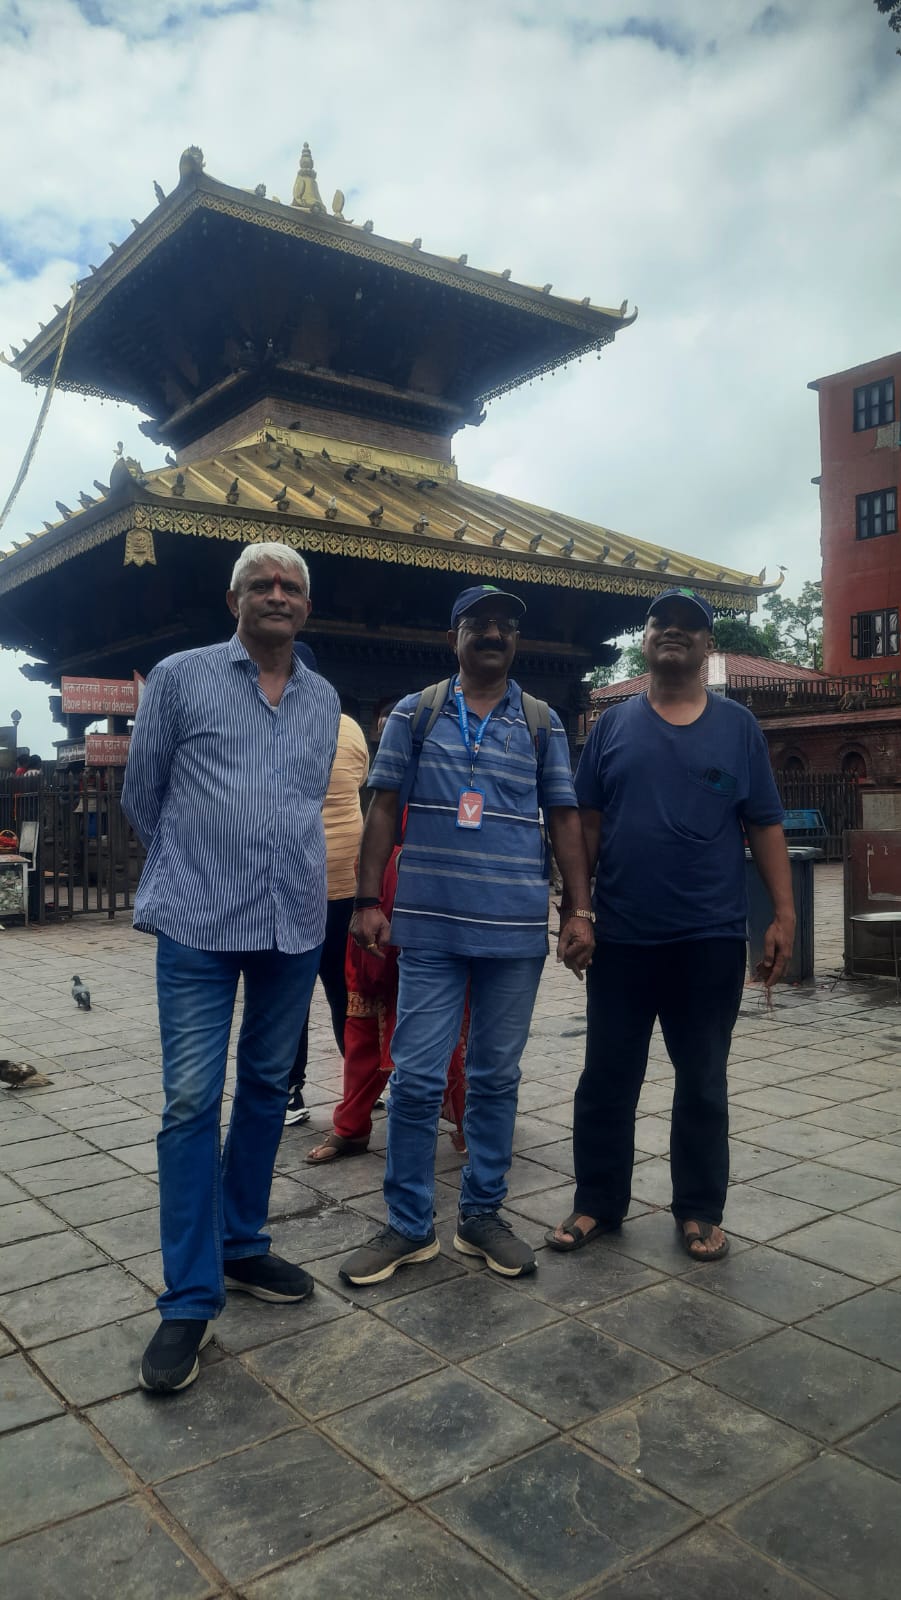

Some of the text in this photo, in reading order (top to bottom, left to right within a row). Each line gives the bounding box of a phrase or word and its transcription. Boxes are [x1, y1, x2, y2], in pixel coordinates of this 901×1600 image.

[64, 697, 134, 713] Above the line for devotees
[463, 803, 480, 818] V
